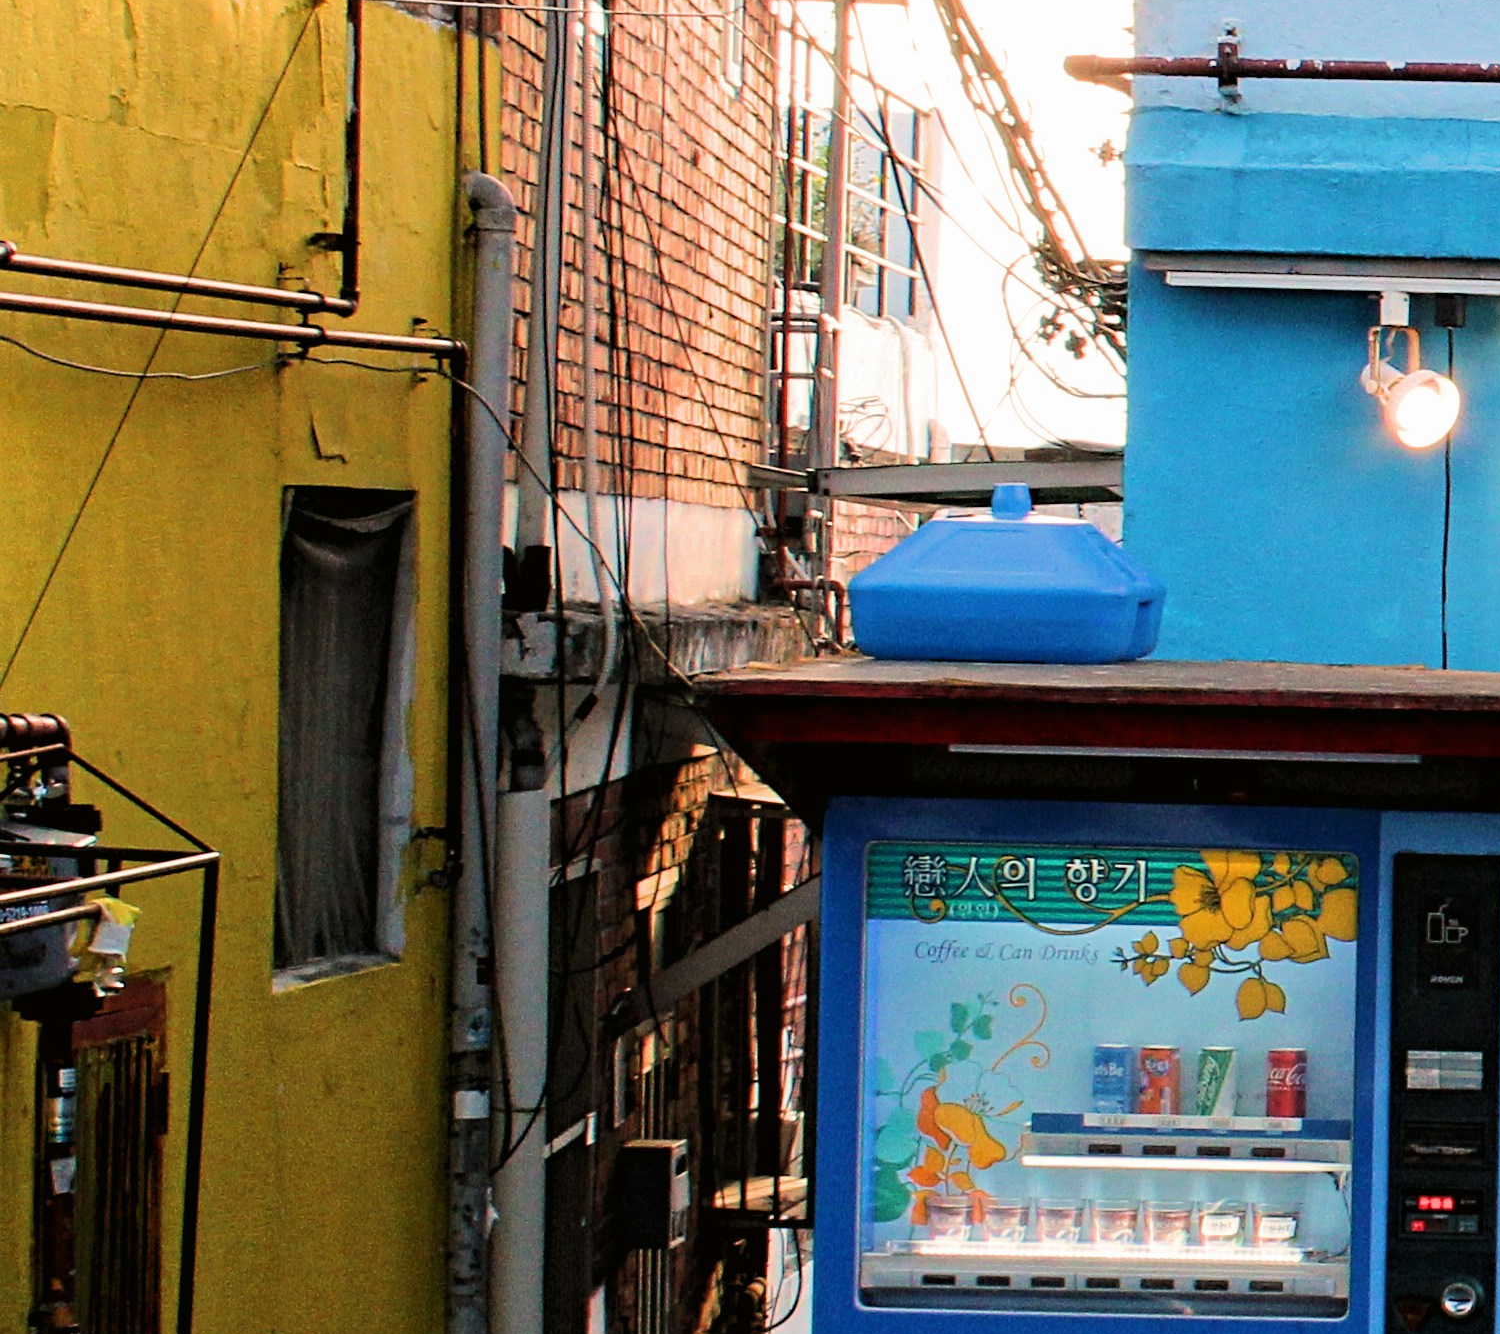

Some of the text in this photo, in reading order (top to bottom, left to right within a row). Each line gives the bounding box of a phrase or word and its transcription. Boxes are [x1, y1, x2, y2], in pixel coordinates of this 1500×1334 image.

[1065, 857, 1149, 903] 향기
[914, 941, 1098, 965] Coffee & Can Drinks
